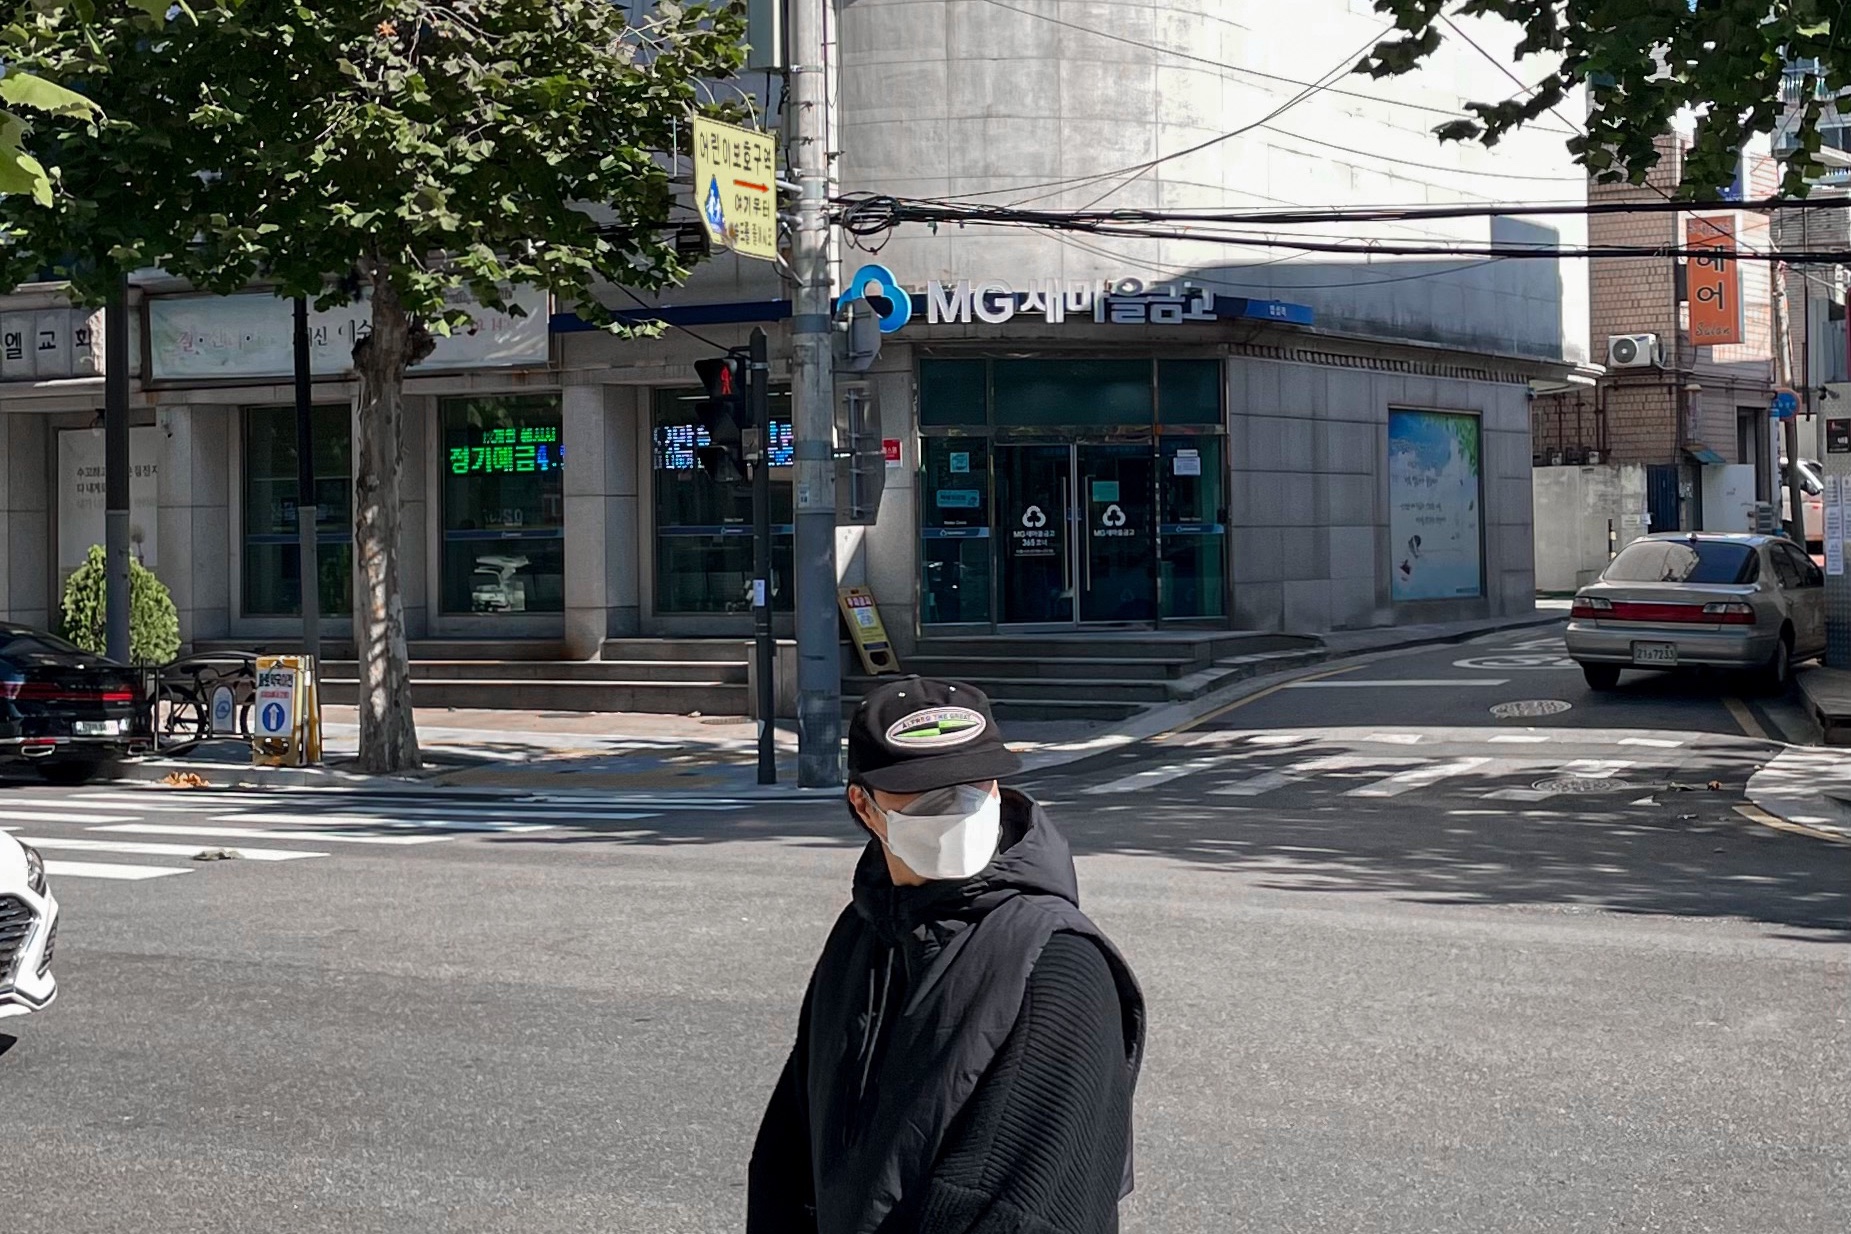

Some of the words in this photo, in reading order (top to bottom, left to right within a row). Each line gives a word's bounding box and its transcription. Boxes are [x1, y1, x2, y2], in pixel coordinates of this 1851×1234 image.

[699, 131, 773, 179] 어린이보호구역
[734, 193, 771, 221] 여기부터
[1695, 321, 1731, 337] Salon
